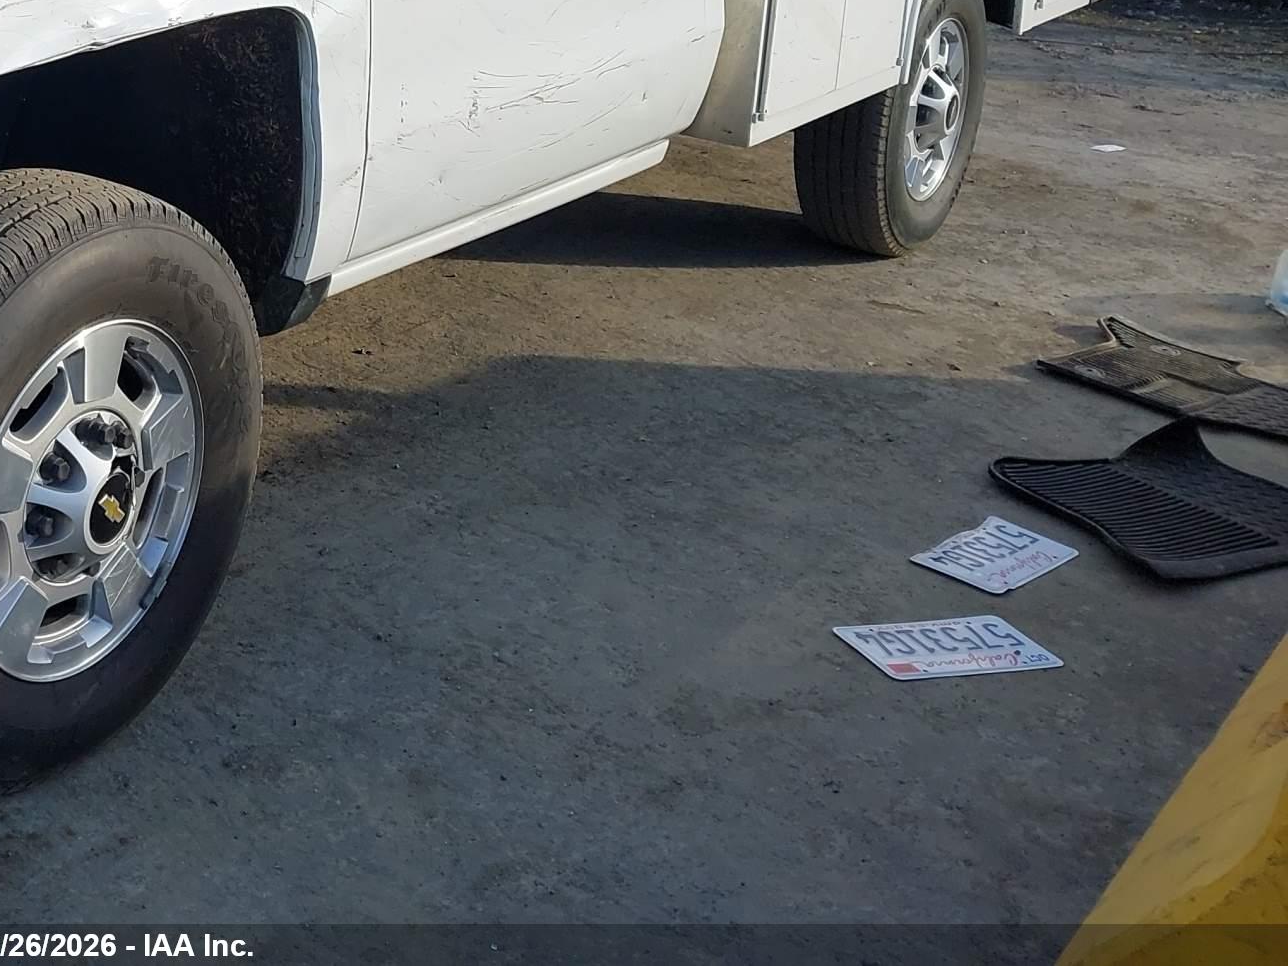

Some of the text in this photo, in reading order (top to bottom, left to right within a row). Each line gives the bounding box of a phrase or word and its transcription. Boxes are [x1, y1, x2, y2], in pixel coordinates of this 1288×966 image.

[930, 524, 1041, 572] 57531G4
[856, 623, 1025, 658] 57531G4
[918, 650, 1020, 669] California
